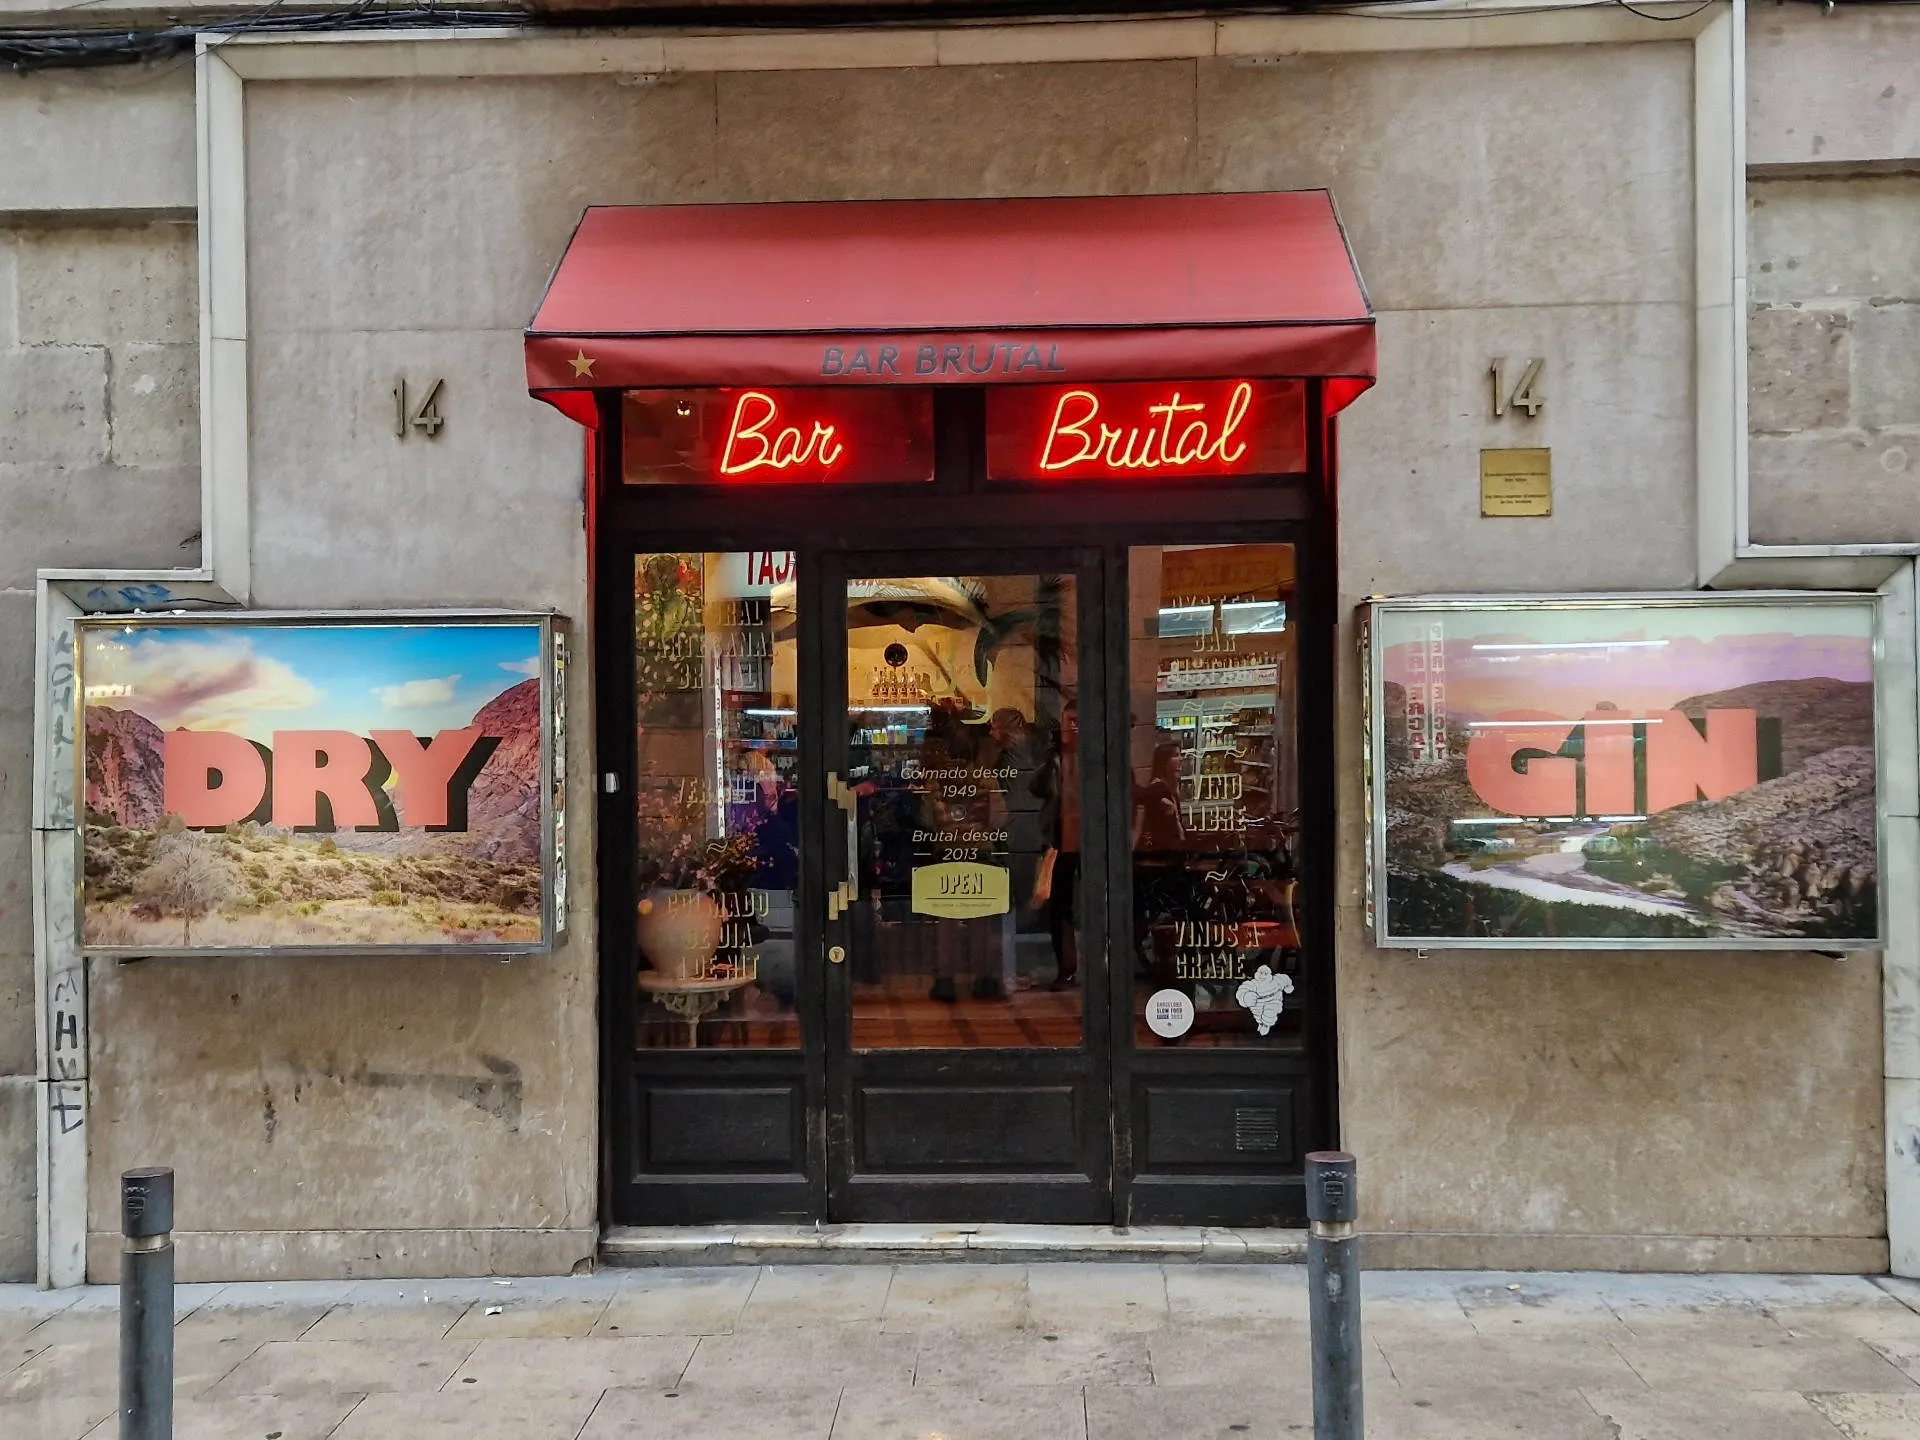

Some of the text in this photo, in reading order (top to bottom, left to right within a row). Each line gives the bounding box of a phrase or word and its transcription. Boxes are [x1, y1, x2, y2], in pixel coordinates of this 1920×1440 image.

[820, 343, 1066, 376] BAR BRUTAL
[1489, 357, 1544, 416] 14
[393, 377, 444, 438] 14
[720, 381, 1253, 475] Bar Brutal
[901, 766, 1018, 780] Colmado desde
[1467, 708, 1759, 817] GIN
[164, 729, 487, 829] DRY
[942, 784, 978, 798] 1949
[1193, 774, 1243, 800] VINO
[1185, 806, 1247, 831] LIBRE
[912, 828, 1009, 842] Brutal desde
[942, 847, 979, 861] 2013
[939, 872, 983, 895] OPEN
[1175, 921, 1240, 948] VINOS
[1175, 951, 1253, 979] GRANE
